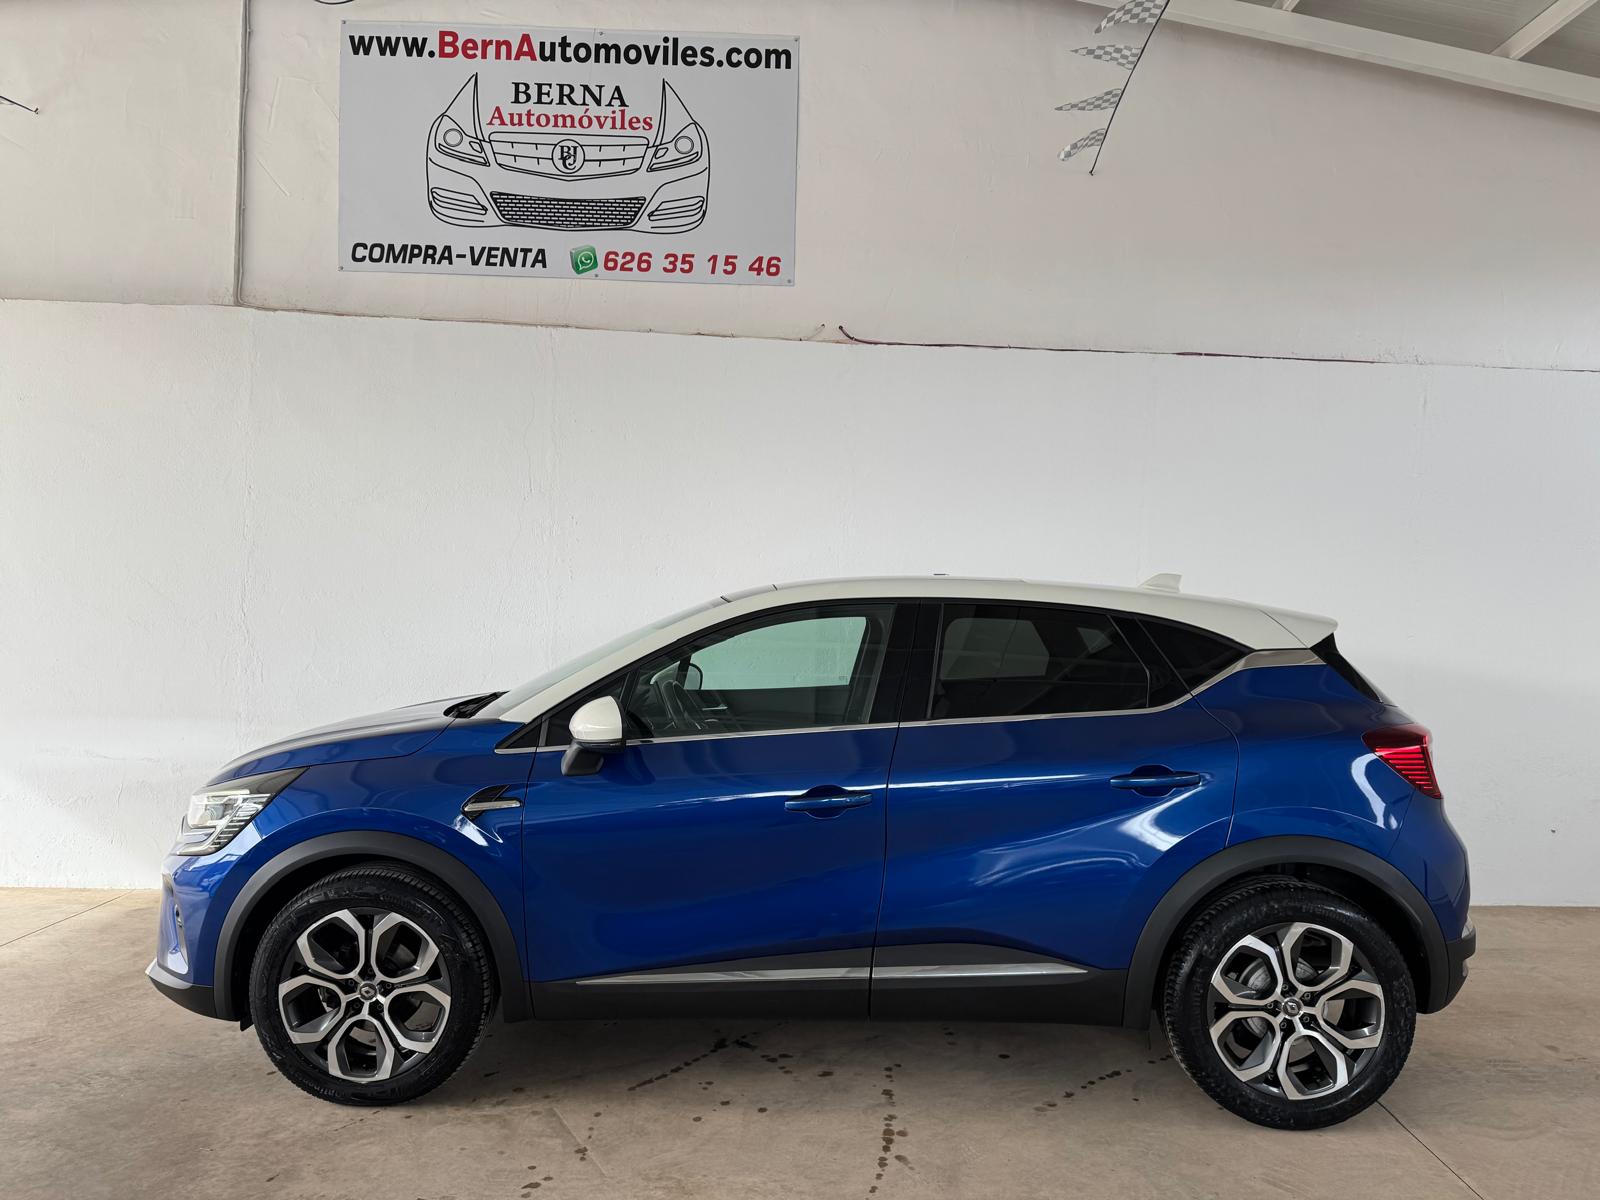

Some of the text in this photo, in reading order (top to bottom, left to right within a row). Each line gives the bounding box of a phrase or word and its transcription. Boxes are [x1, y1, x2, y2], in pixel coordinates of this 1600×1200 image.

[348, 30, 792, 70] www.BernAutomoviles.com
[511, 81, 629, 108] BERNA
[486, 105, 653, 132] Automóviles
[351, 242, 548, 269] COMPRA-VENTA
[603, 250, 782, 277] 626 35 15 46
